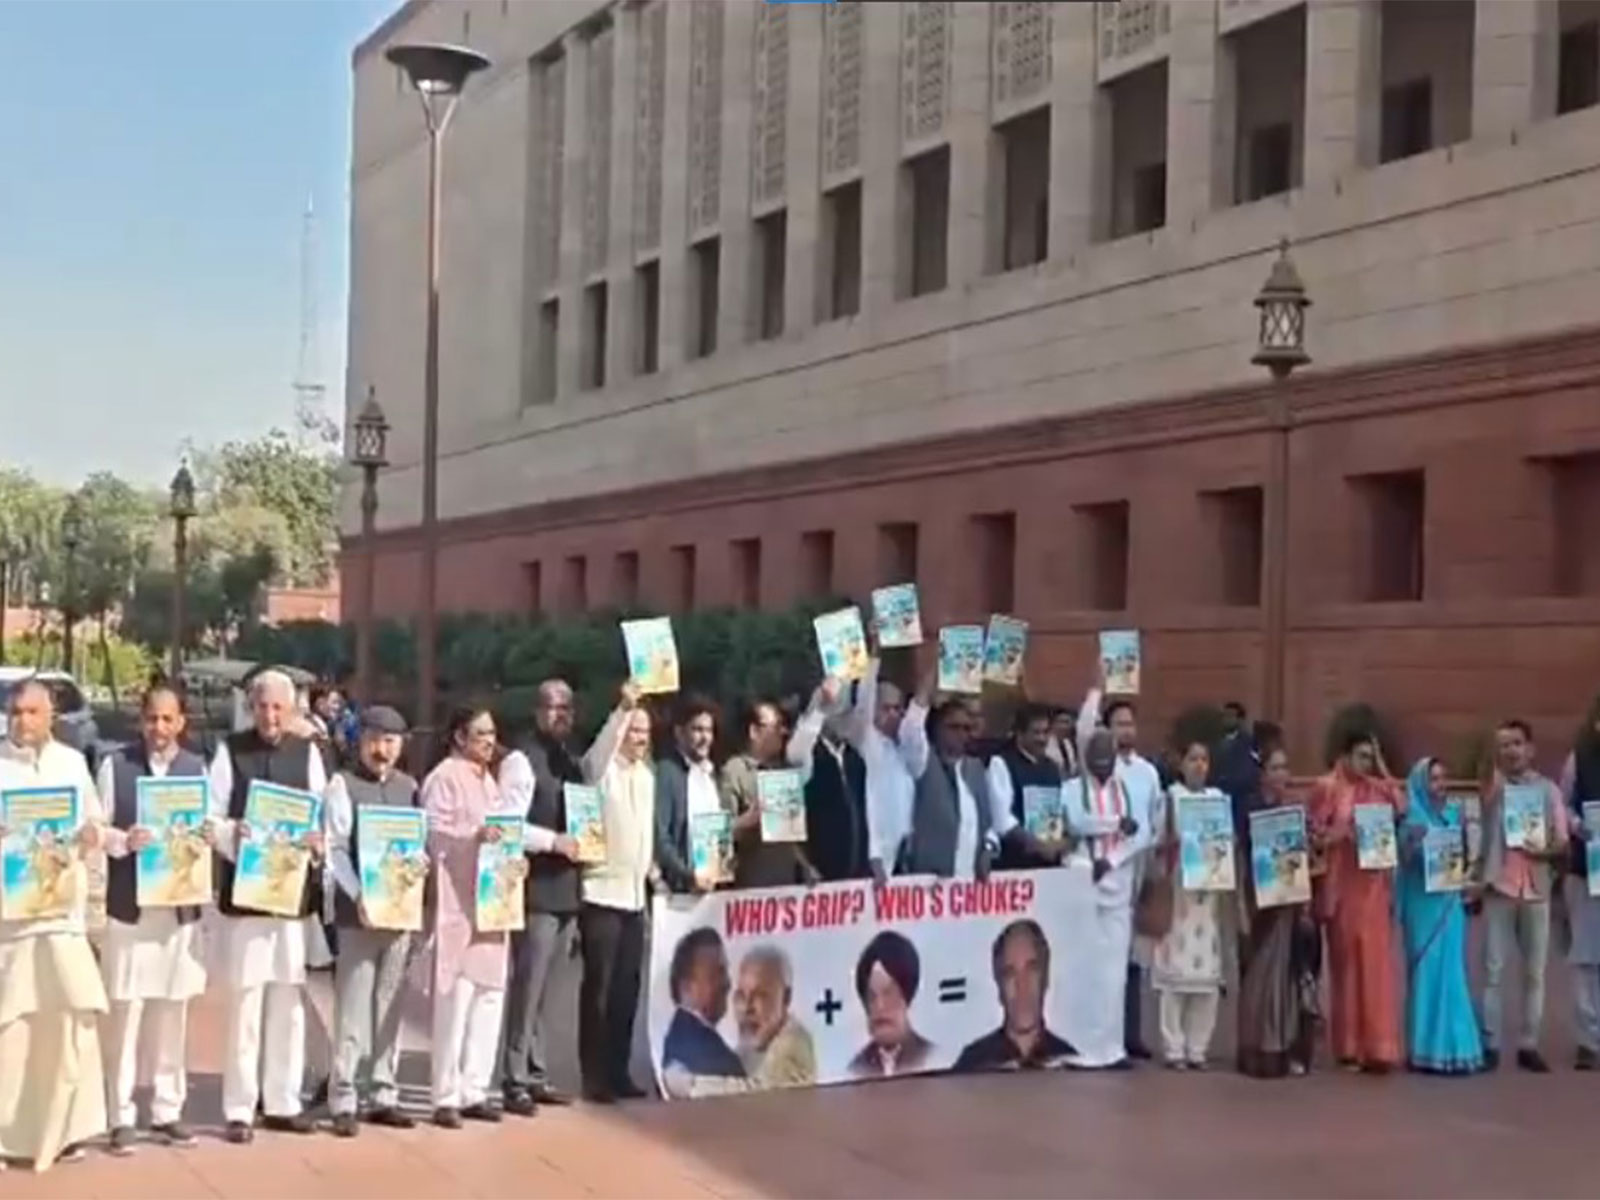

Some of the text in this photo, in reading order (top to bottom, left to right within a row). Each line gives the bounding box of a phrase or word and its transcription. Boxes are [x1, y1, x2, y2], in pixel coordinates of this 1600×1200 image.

[725, 879, 1034, 938] WHO'S GRIP? WHO'S CHOKE?
